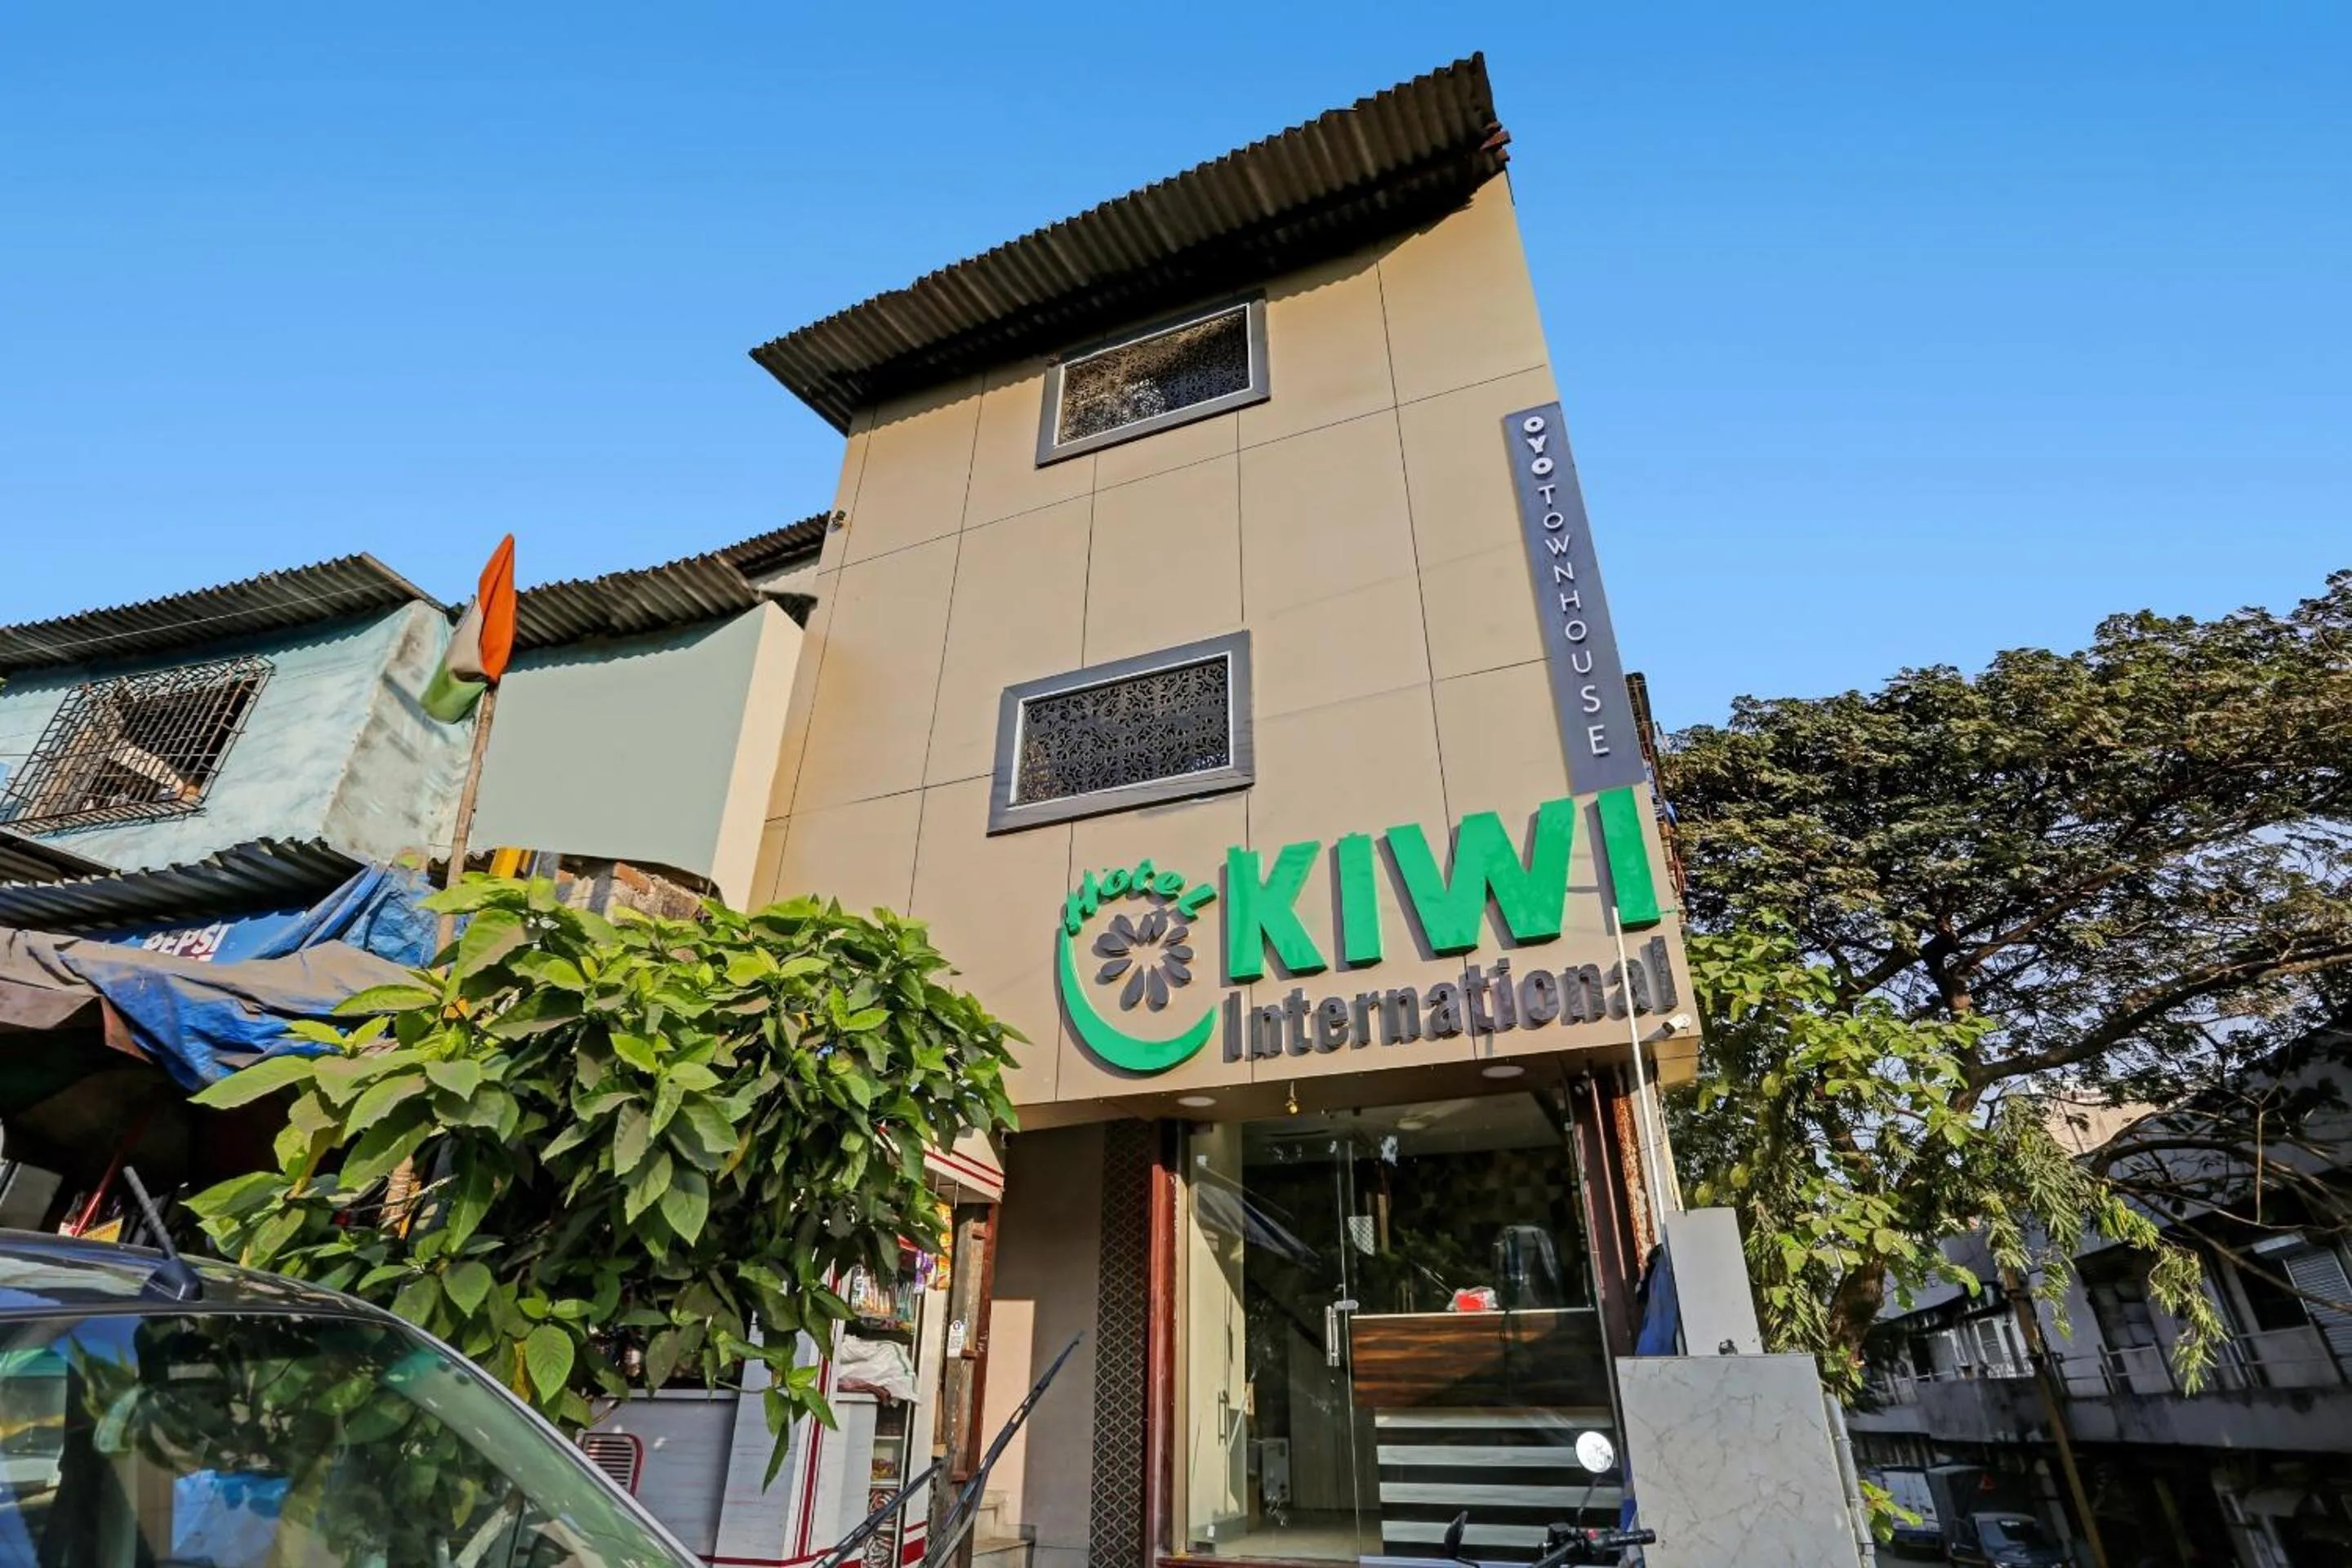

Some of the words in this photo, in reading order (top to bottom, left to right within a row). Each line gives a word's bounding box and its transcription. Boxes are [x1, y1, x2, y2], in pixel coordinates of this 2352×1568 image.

[1522, 415, 1554, 476] OYO
[1538, 483, 1610, 757] TOWNHOUSE
[142, 922, 231, 956] PEPSI
[1063, 858, 1218, 938] Hotel
[1226, 786, 1661, 985] KIWI
[1223, 935, 1679, 1063] International
